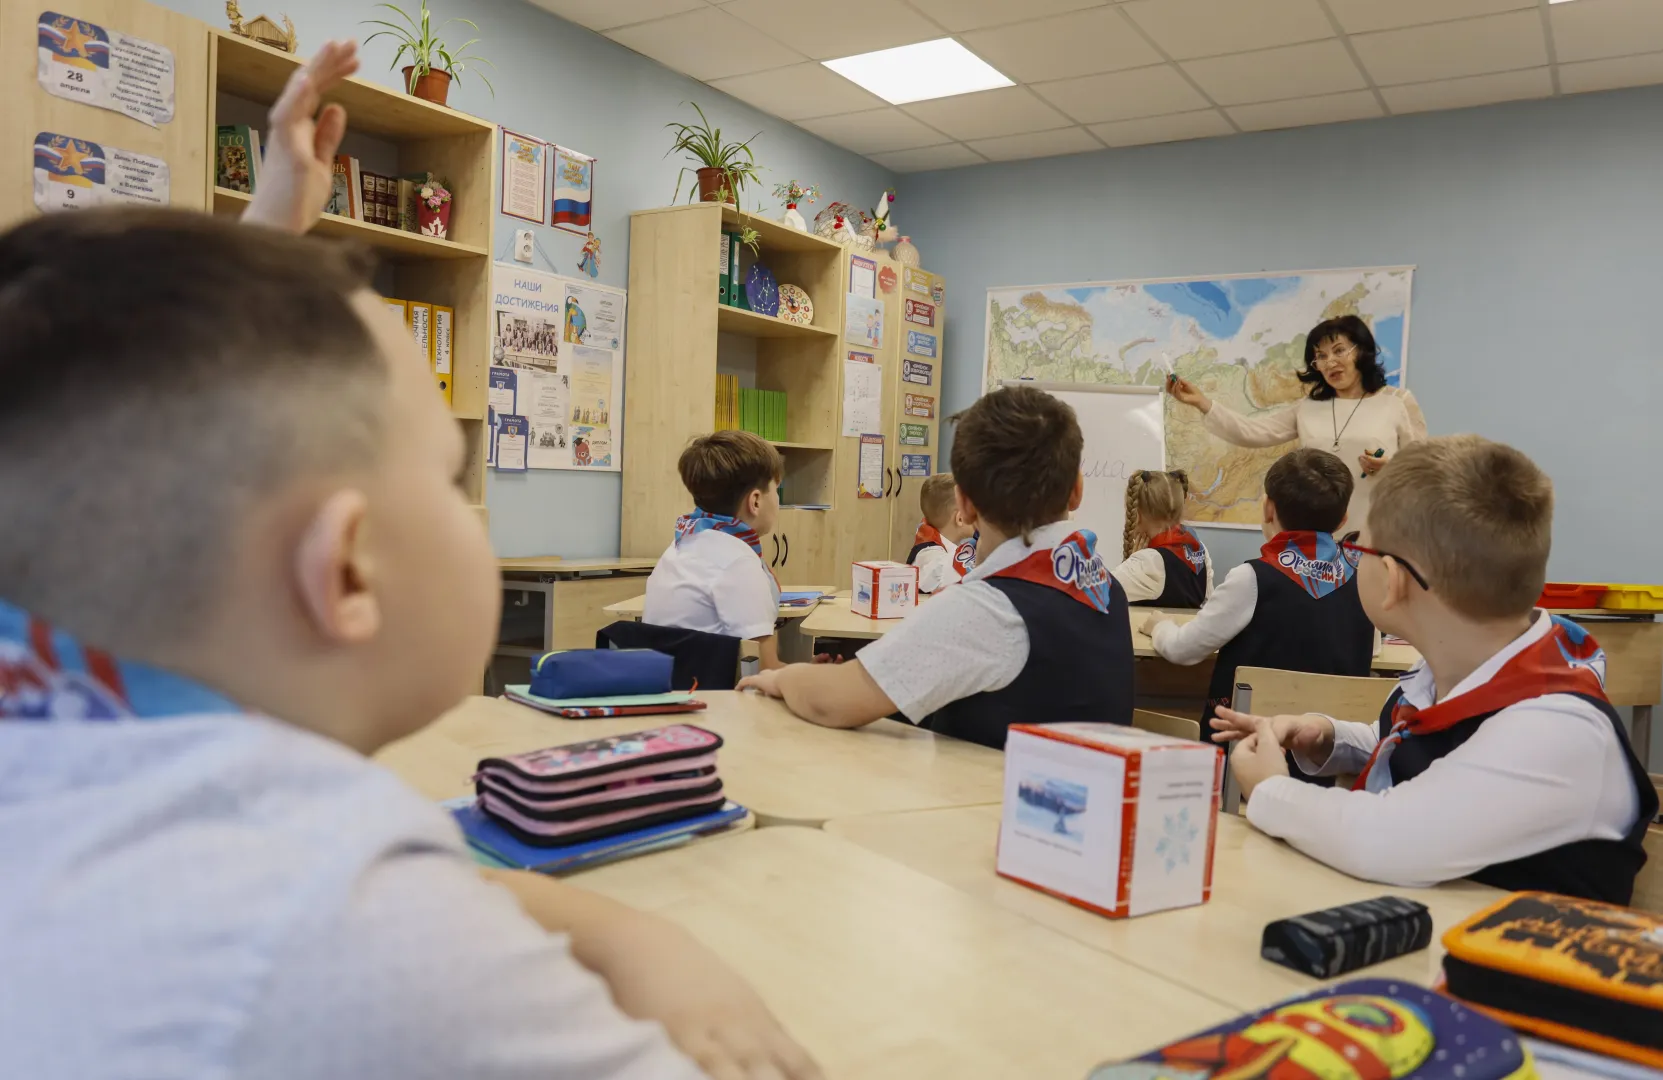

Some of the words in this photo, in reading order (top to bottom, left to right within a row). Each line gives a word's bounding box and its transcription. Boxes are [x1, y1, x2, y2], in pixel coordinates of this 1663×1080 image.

[67, 70, 83, 82] 28
[60, 82, 90, 94] апреля
[218, 135, 244, 148] ЕТО
[67, 189, 75, 199] 9
[433, 224, 439, 236] 1
[514, 279, 542, 293] НАШИ
[495, 294, 559, 313] ДОСТИЖЕНИЯ
[1081, 459, 1128, 480] ма
